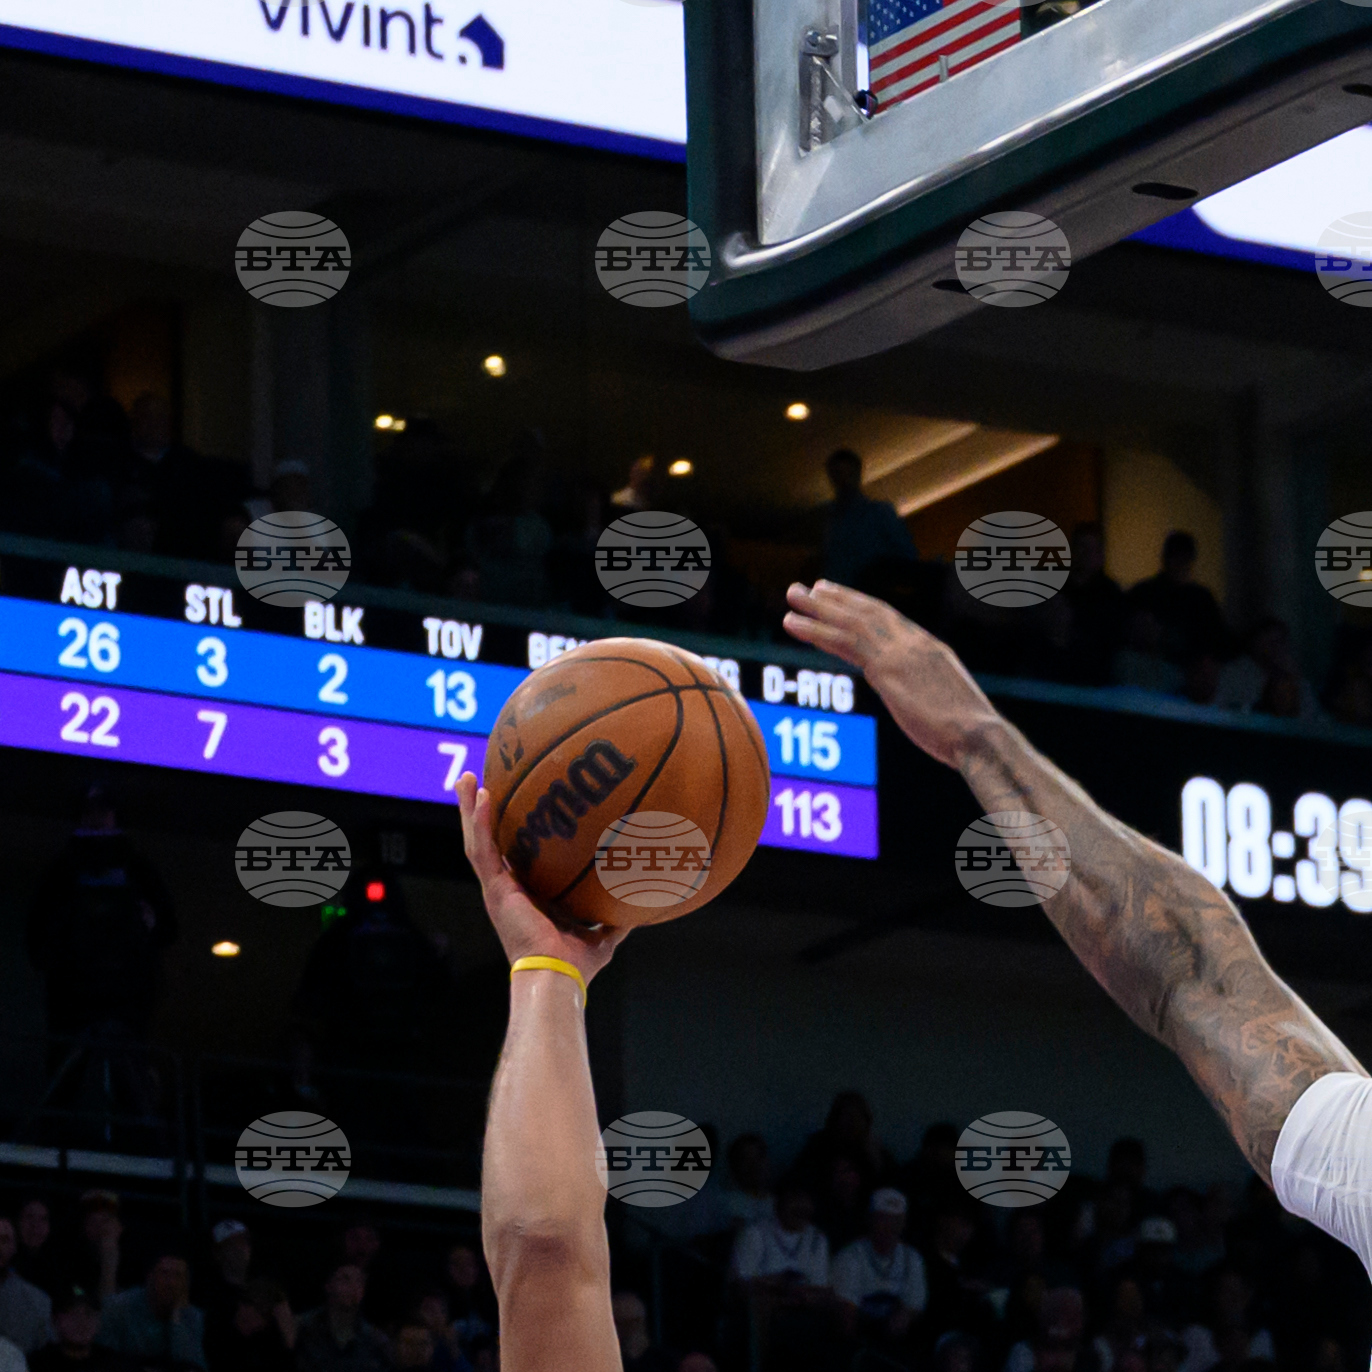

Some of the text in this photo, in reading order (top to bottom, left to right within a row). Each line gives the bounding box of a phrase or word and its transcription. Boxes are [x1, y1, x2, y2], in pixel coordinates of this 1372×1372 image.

[58, 617, 841, 771] 26 3 2 13 115
[60, 567, 122, 611] AST
[185, 584, 242, 627] STL
[304, 601, 364, 645] BLK
[423, 617, 483, 661] TOV
[762, 665, 854, 713] D-RTG
[60, 692, 842, 843] 22 7 3 7 113
